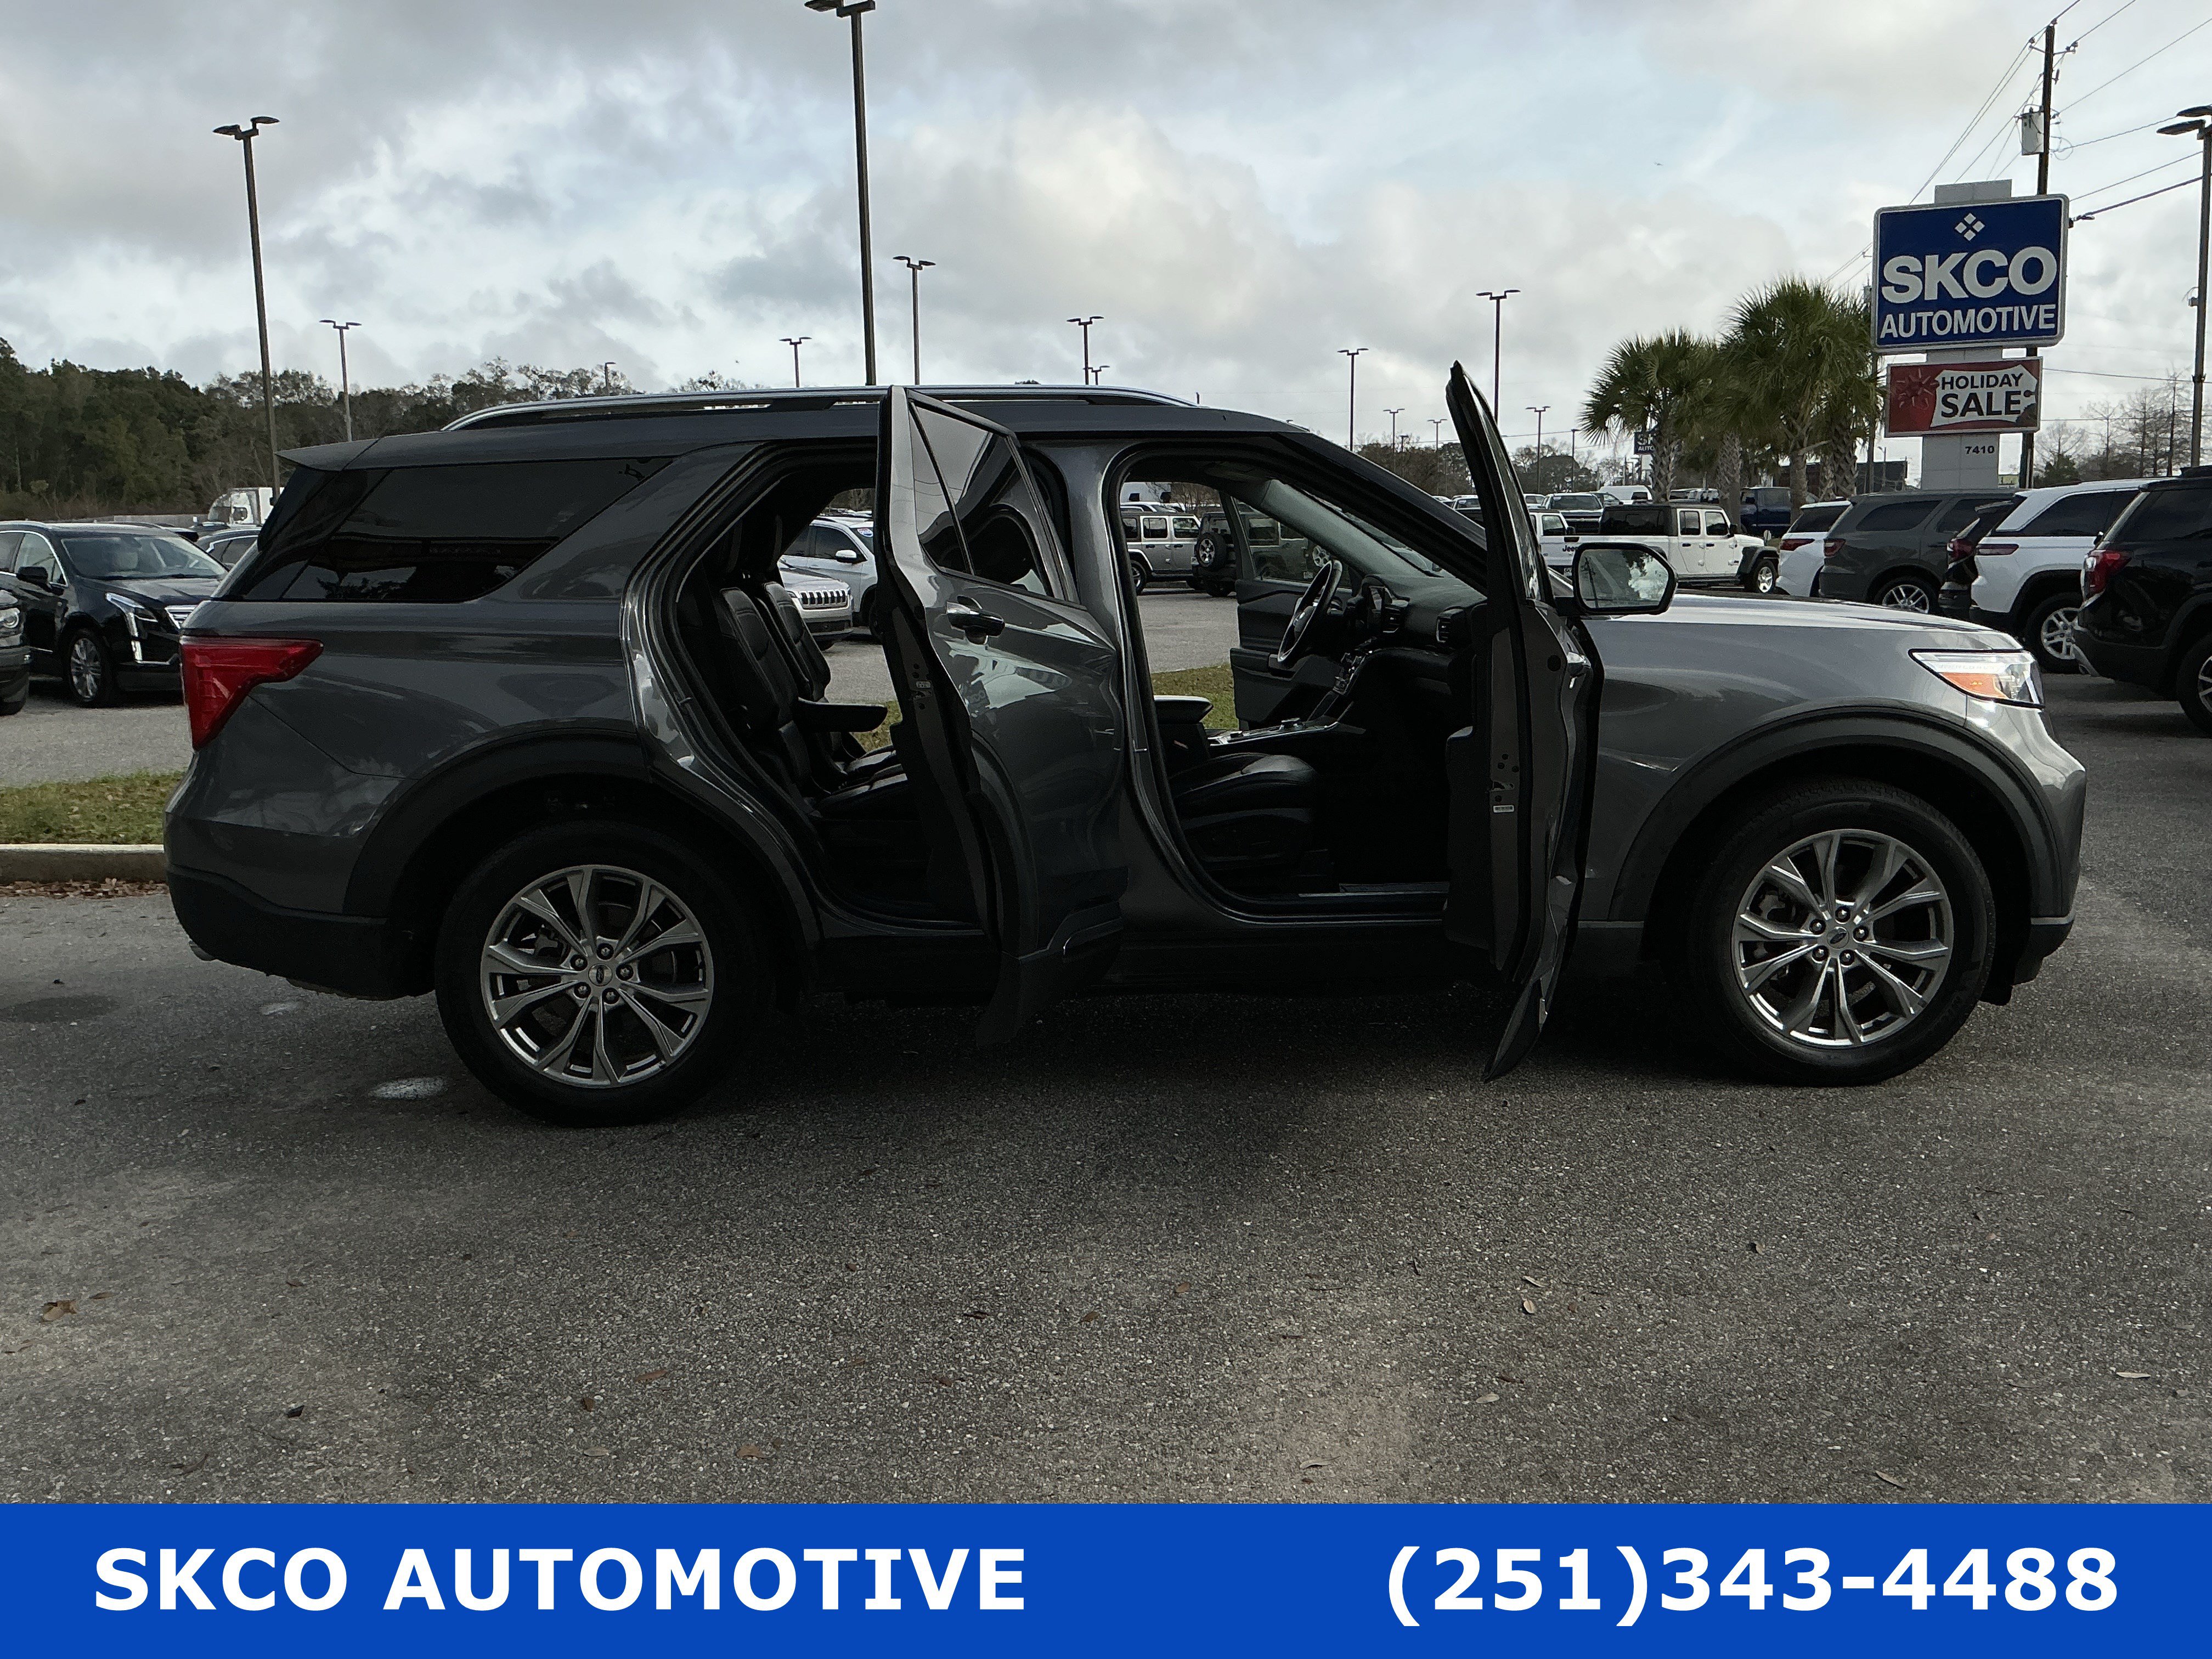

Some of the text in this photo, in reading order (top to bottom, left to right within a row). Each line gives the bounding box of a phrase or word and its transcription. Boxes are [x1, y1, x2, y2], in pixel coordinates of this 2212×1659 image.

[1881, 246, 2057, 303] SKCO
[1880, 304, 2056, 339] AUTOMOTIVE
[1941, 373, 2023, 390] HOLIDAY
[1940, 390, 2022, 418] SALE
[1965, 445, 1995, 454] 7410
